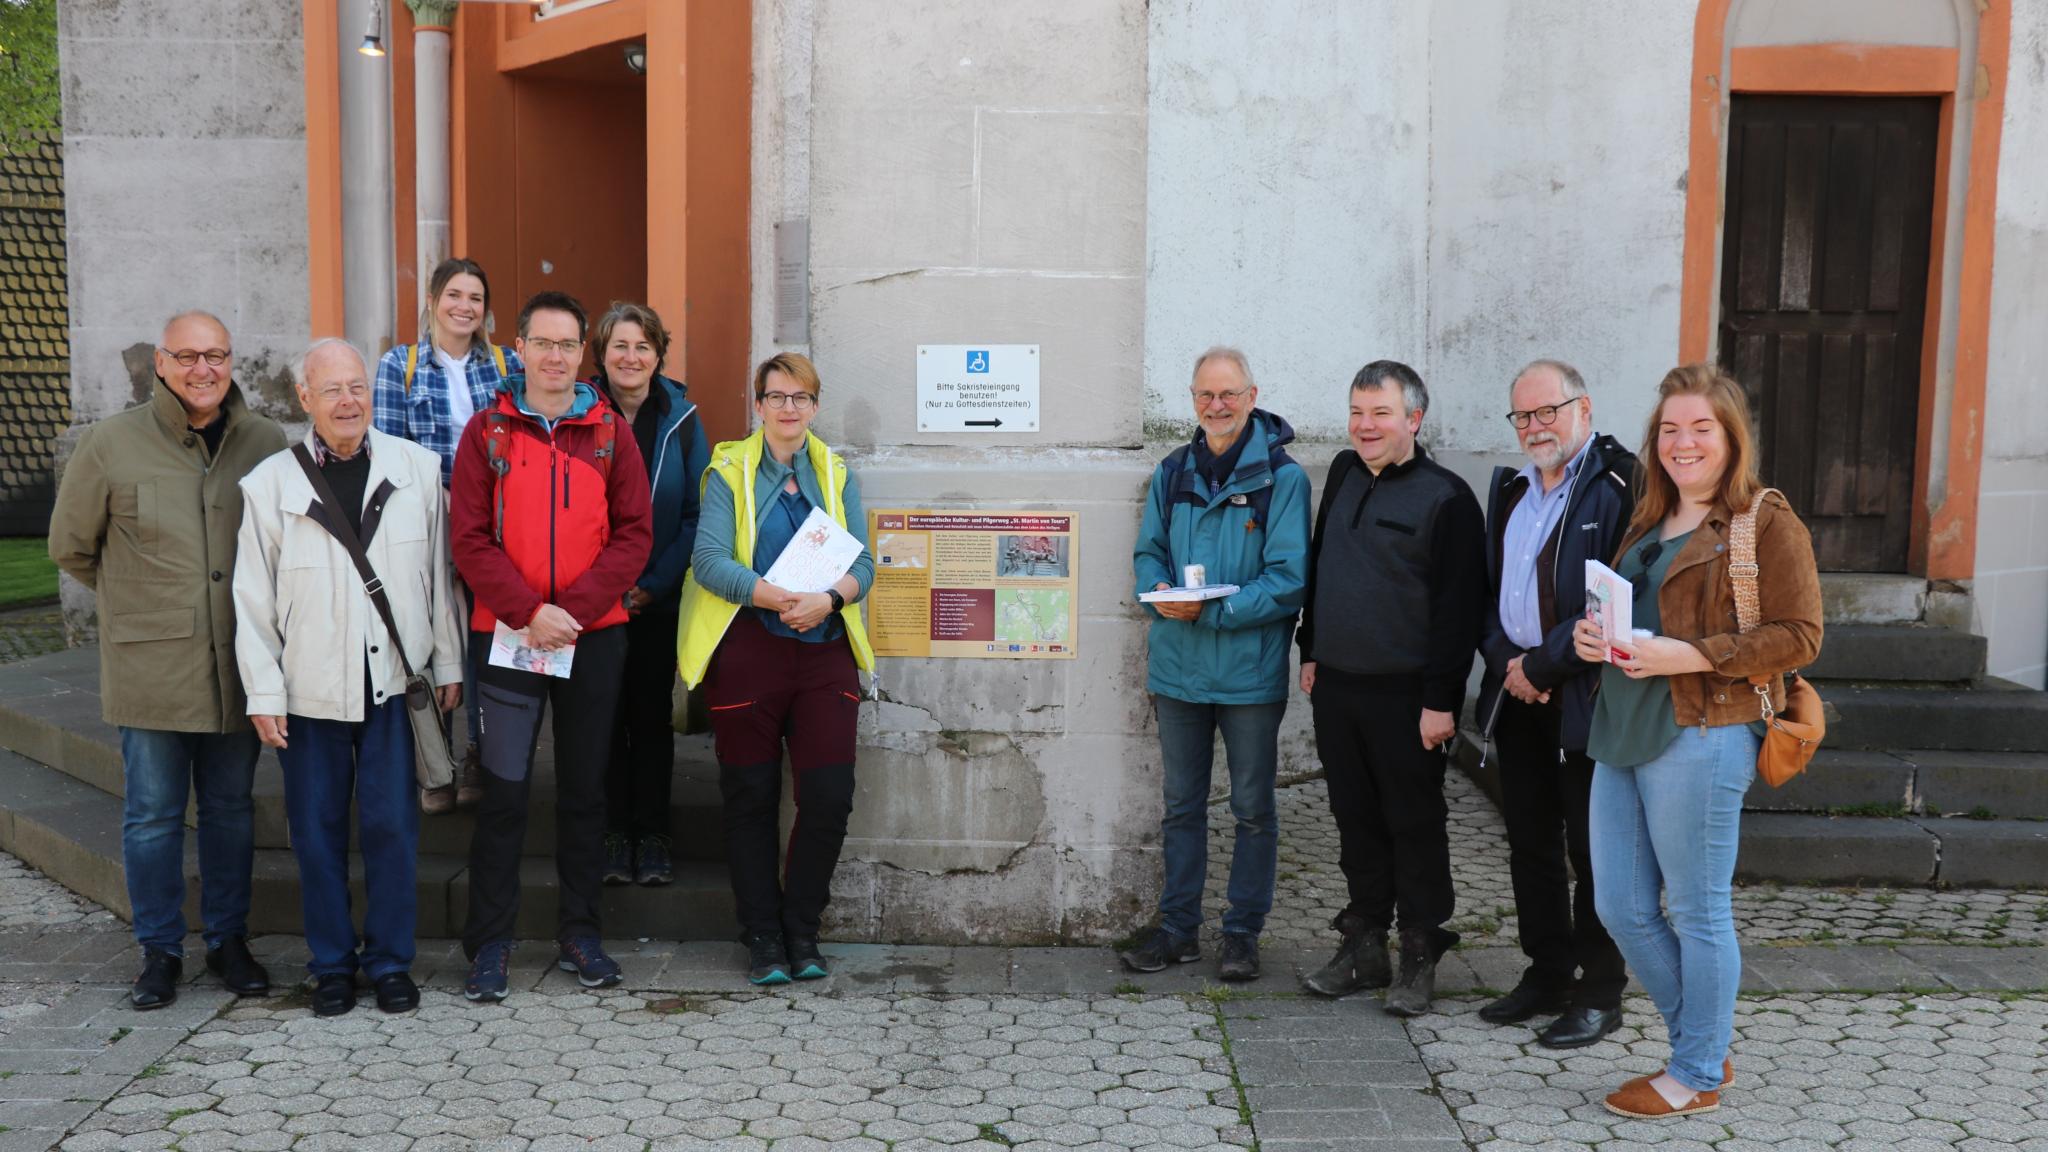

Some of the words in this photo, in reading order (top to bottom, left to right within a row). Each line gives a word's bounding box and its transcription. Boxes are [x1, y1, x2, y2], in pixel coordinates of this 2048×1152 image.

[936, 383, 954, 391] Bitte
[957, 383, 1020, 392] Sakristeieingang
[925, 400, 942, 409] (Nur
[956, 400, 1031, 409] Gottesdienstzeiten)
[920, 516, 952, 524] europäische
[982, 517, 1009, 525] Pilgerweg
